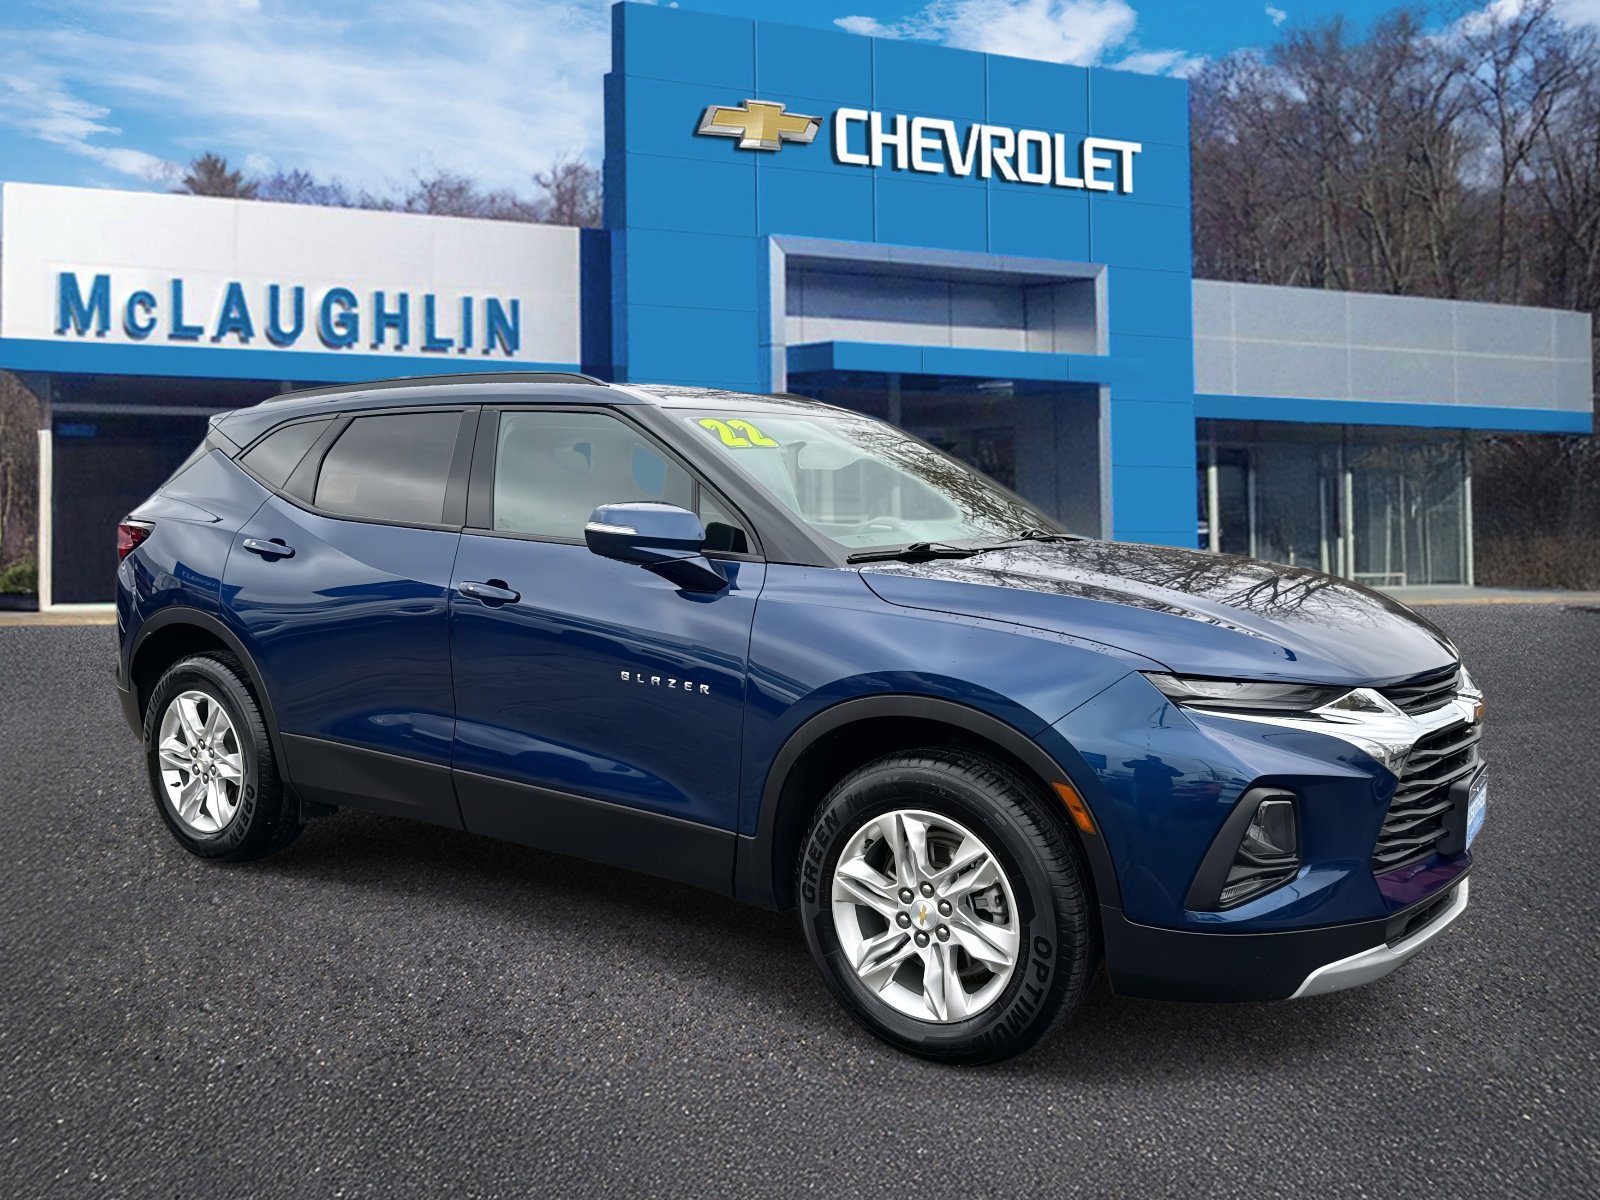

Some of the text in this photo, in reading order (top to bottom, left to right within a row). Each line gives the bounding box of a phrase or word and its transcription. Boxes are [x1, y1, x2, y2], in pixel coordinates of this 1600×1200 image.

[833, 107, 1142, 194] CHEVROLET
[698, 418, 780, 449] 22
[620, 670, 710, 695] BLAZER
[229, 783, 256, 847] GREEN
[801, 806, 841, 904] GREEN
